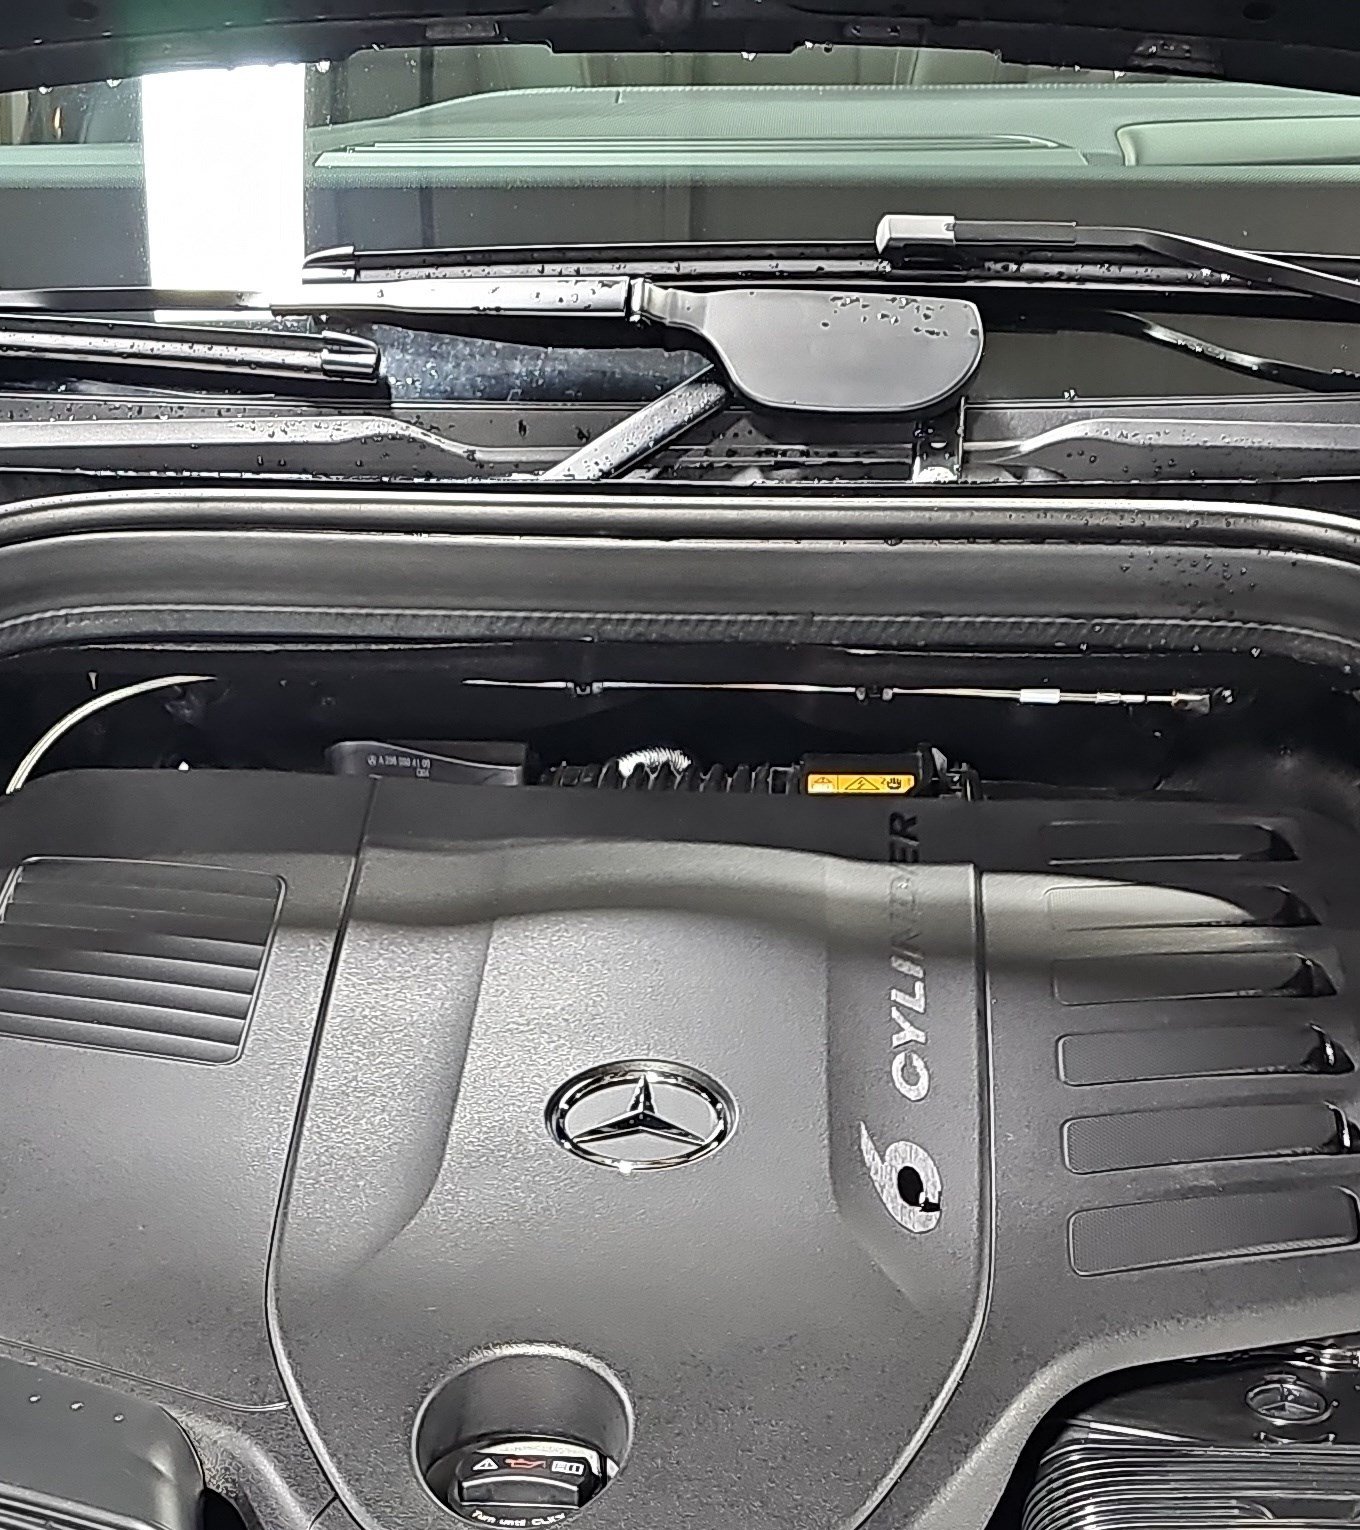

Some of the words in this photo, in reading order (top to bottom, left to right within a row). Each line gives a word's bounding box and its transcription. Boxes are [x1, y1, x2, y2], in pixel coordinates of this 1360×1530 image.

[889, 811, 931, 1102] CYLINDER
[471, 1509, 497, 1524] Turn
[499, 1518, 526, 1527] until
